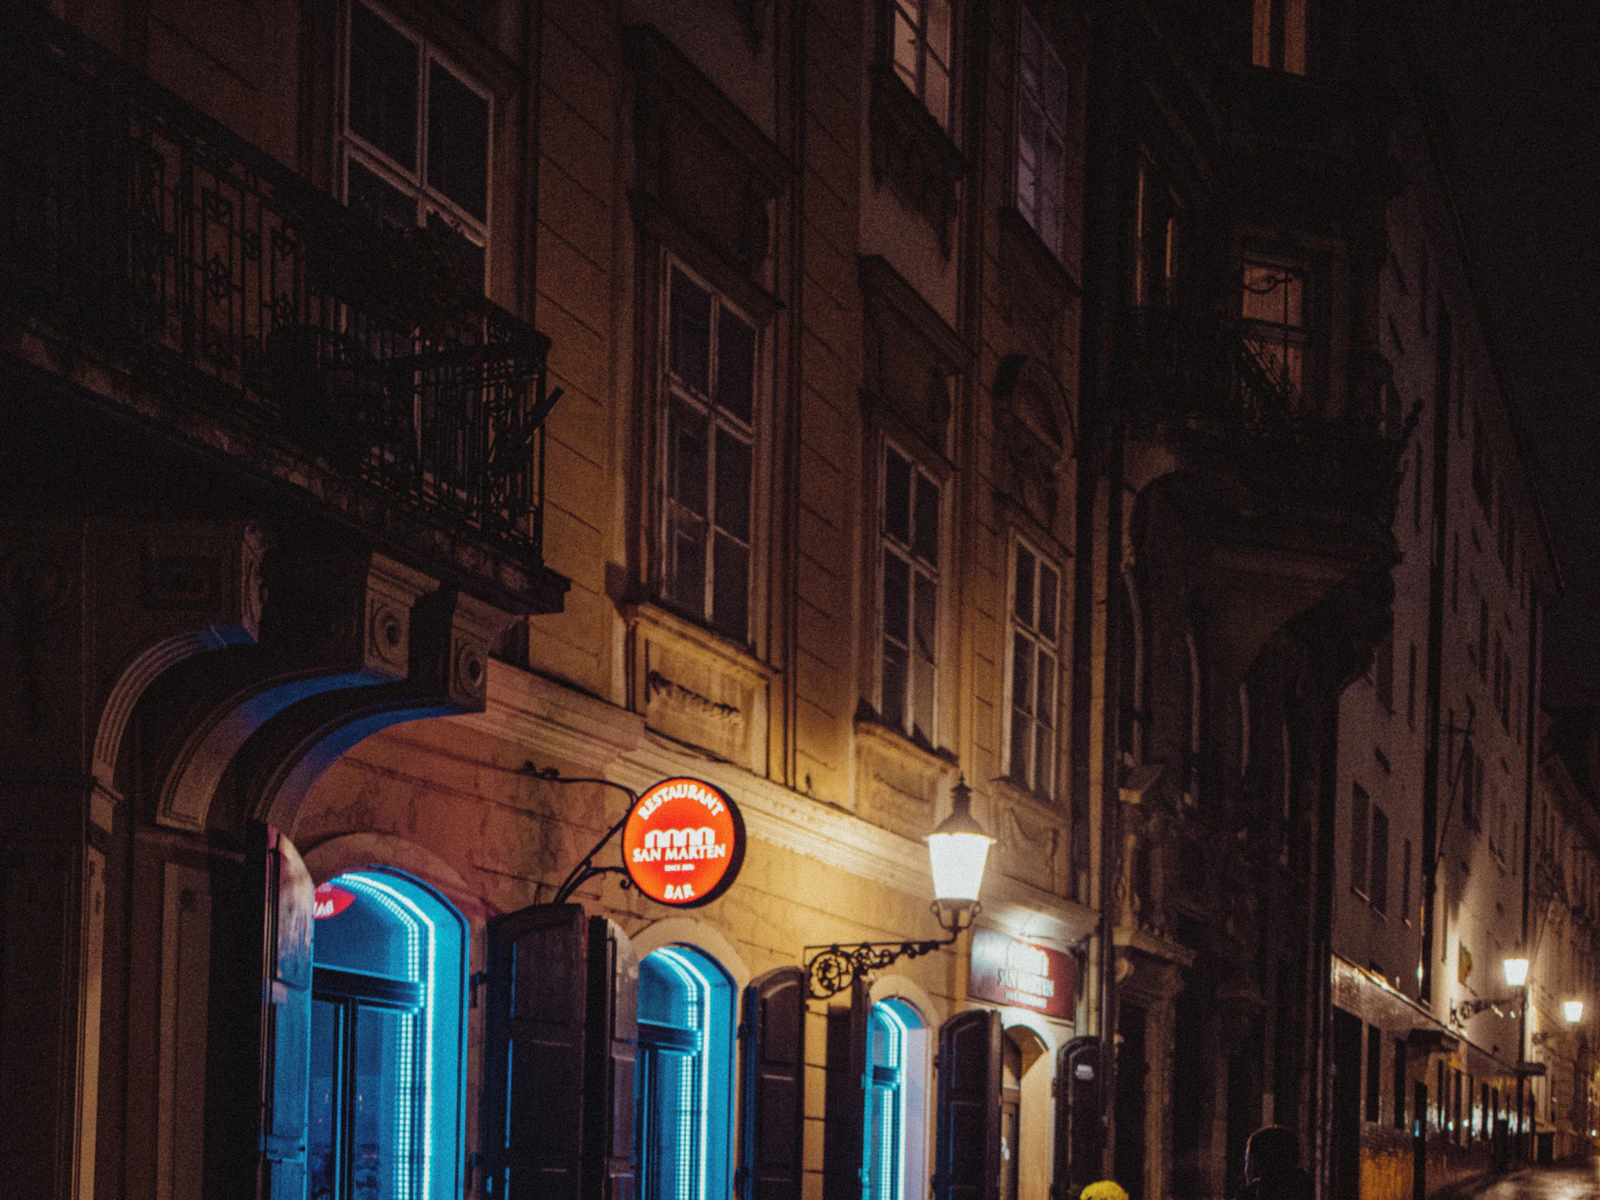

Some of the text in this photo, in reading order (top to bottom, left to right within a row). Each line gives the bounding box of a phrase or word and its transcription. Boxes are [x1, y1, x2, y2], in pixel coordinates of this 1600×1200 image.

[637, 784, 725, 820] RESTAURANT
[633, 844, 726, 862] SAN MARTEN
[664, 884, 695, 900] BAR
